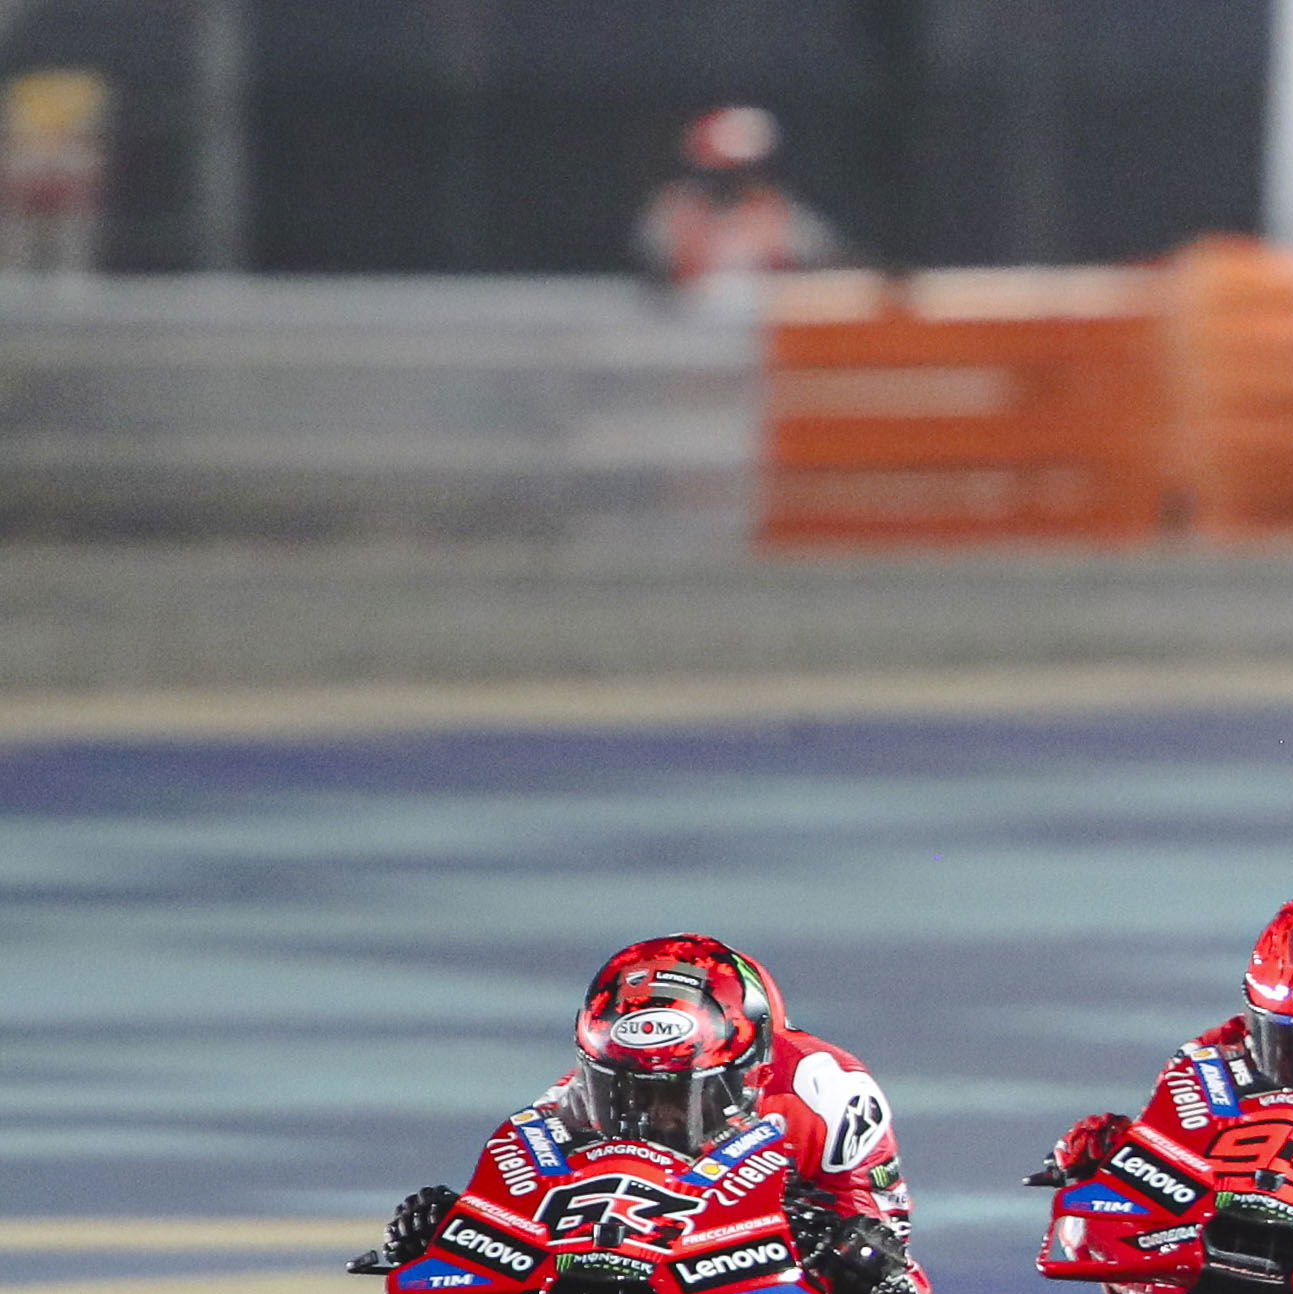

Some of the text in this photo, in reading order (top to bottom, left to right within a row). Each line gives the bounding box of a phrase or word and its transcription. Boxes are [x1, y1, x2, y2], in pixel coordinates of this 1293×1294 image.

[656, 971, 700, 987] Lenovo
[1110, 1146, 1196, 1203] Lenovo
[537, 1174, 707, 1253] 63
[1091, 1200, 1133, 1213] TIM
[441, 1217, 534, 1272] Lenovo
[682, 1214, 783, 1246] FRECCIAROSSA
[429, 1273, 475, 1288] TIM
[675, 1242, 788, 1285] Lenovo
